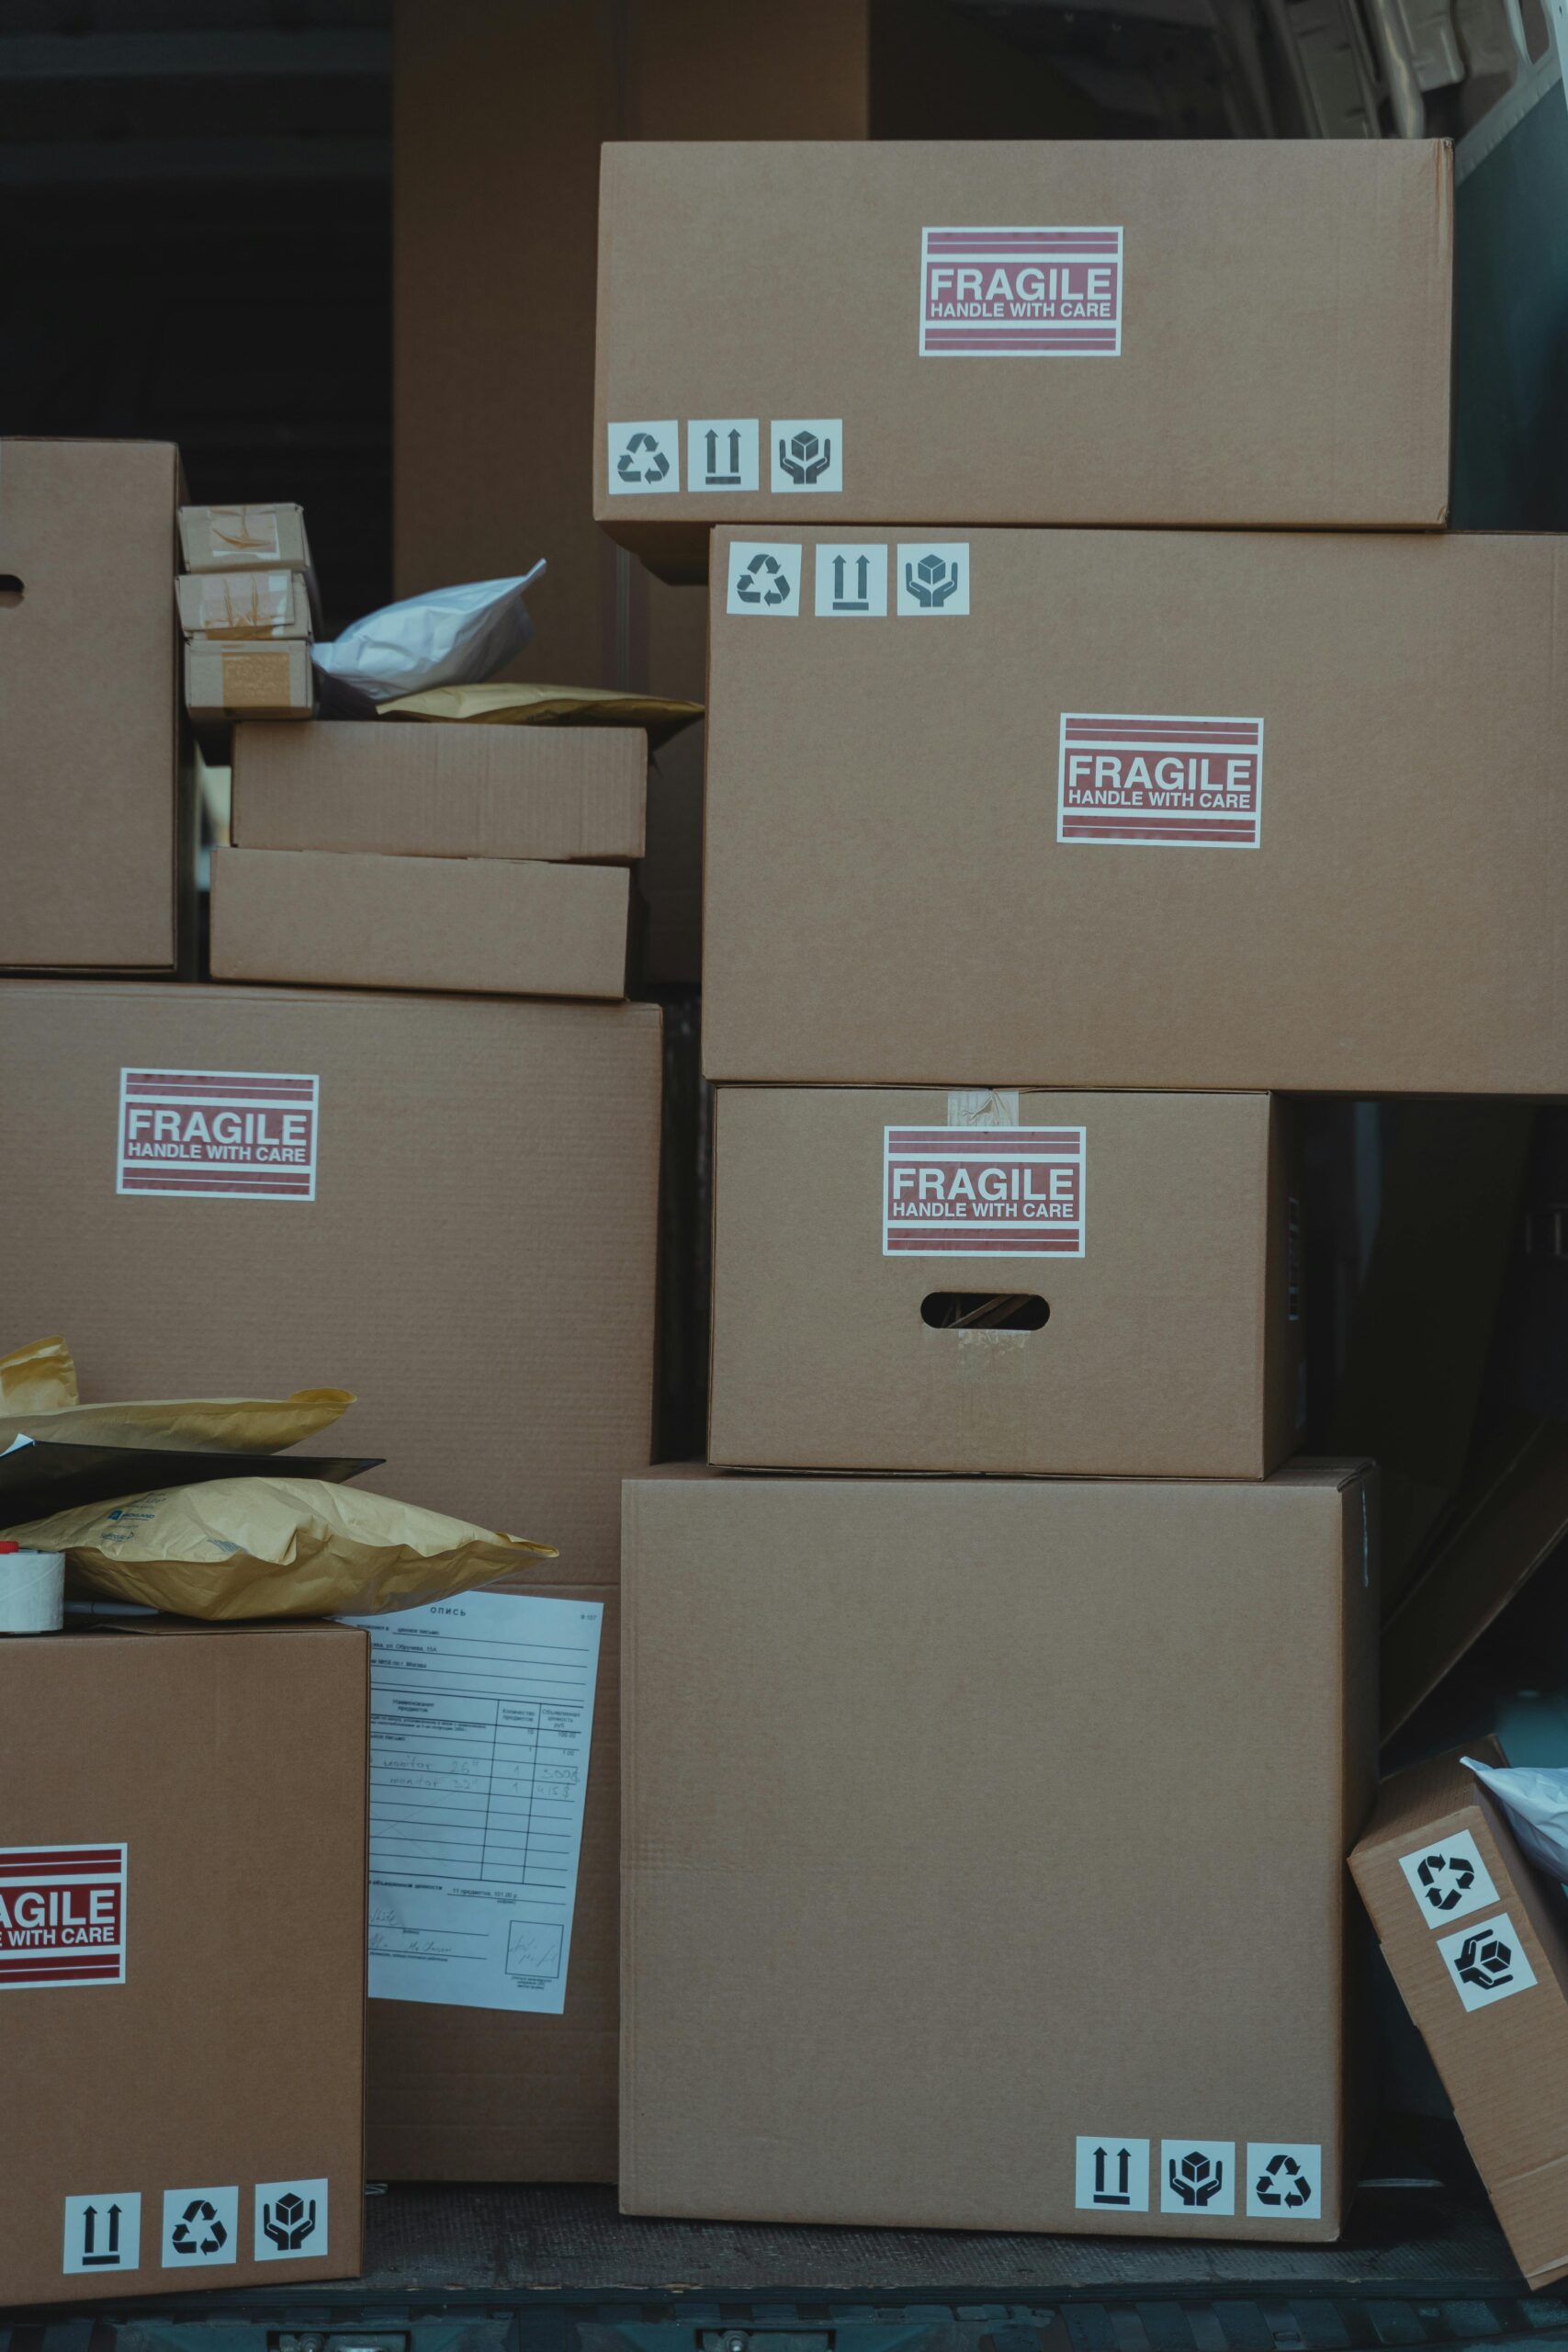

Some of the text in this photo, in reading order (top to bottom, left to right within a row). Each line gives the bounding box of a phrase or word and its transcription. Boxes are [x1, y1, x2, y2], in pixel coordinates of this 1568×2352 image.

[931, 268, 1111, 300] FRAGILE
[931, 302, 1111, 318] HANDLE WITH CARE
[1068, 755, 1251, 791] FRAGILE
[1068, 789, 1250, 808] HANDLE WITH CARE
[128, 1109, 307, 1147] FRAGILE
[128, 1143, 306, 1163] HANDLE WITH CARE
[893, 1168, 1074, 1201] FRAGILE
[893, 1202, 1074, 1218] HANDLE WITH CARE
[430, 1606, 467, 1616] ОПИСЬ
[8, 1928, 56, 1947] WITH
[62, 1927, 115, 1944] CARE
